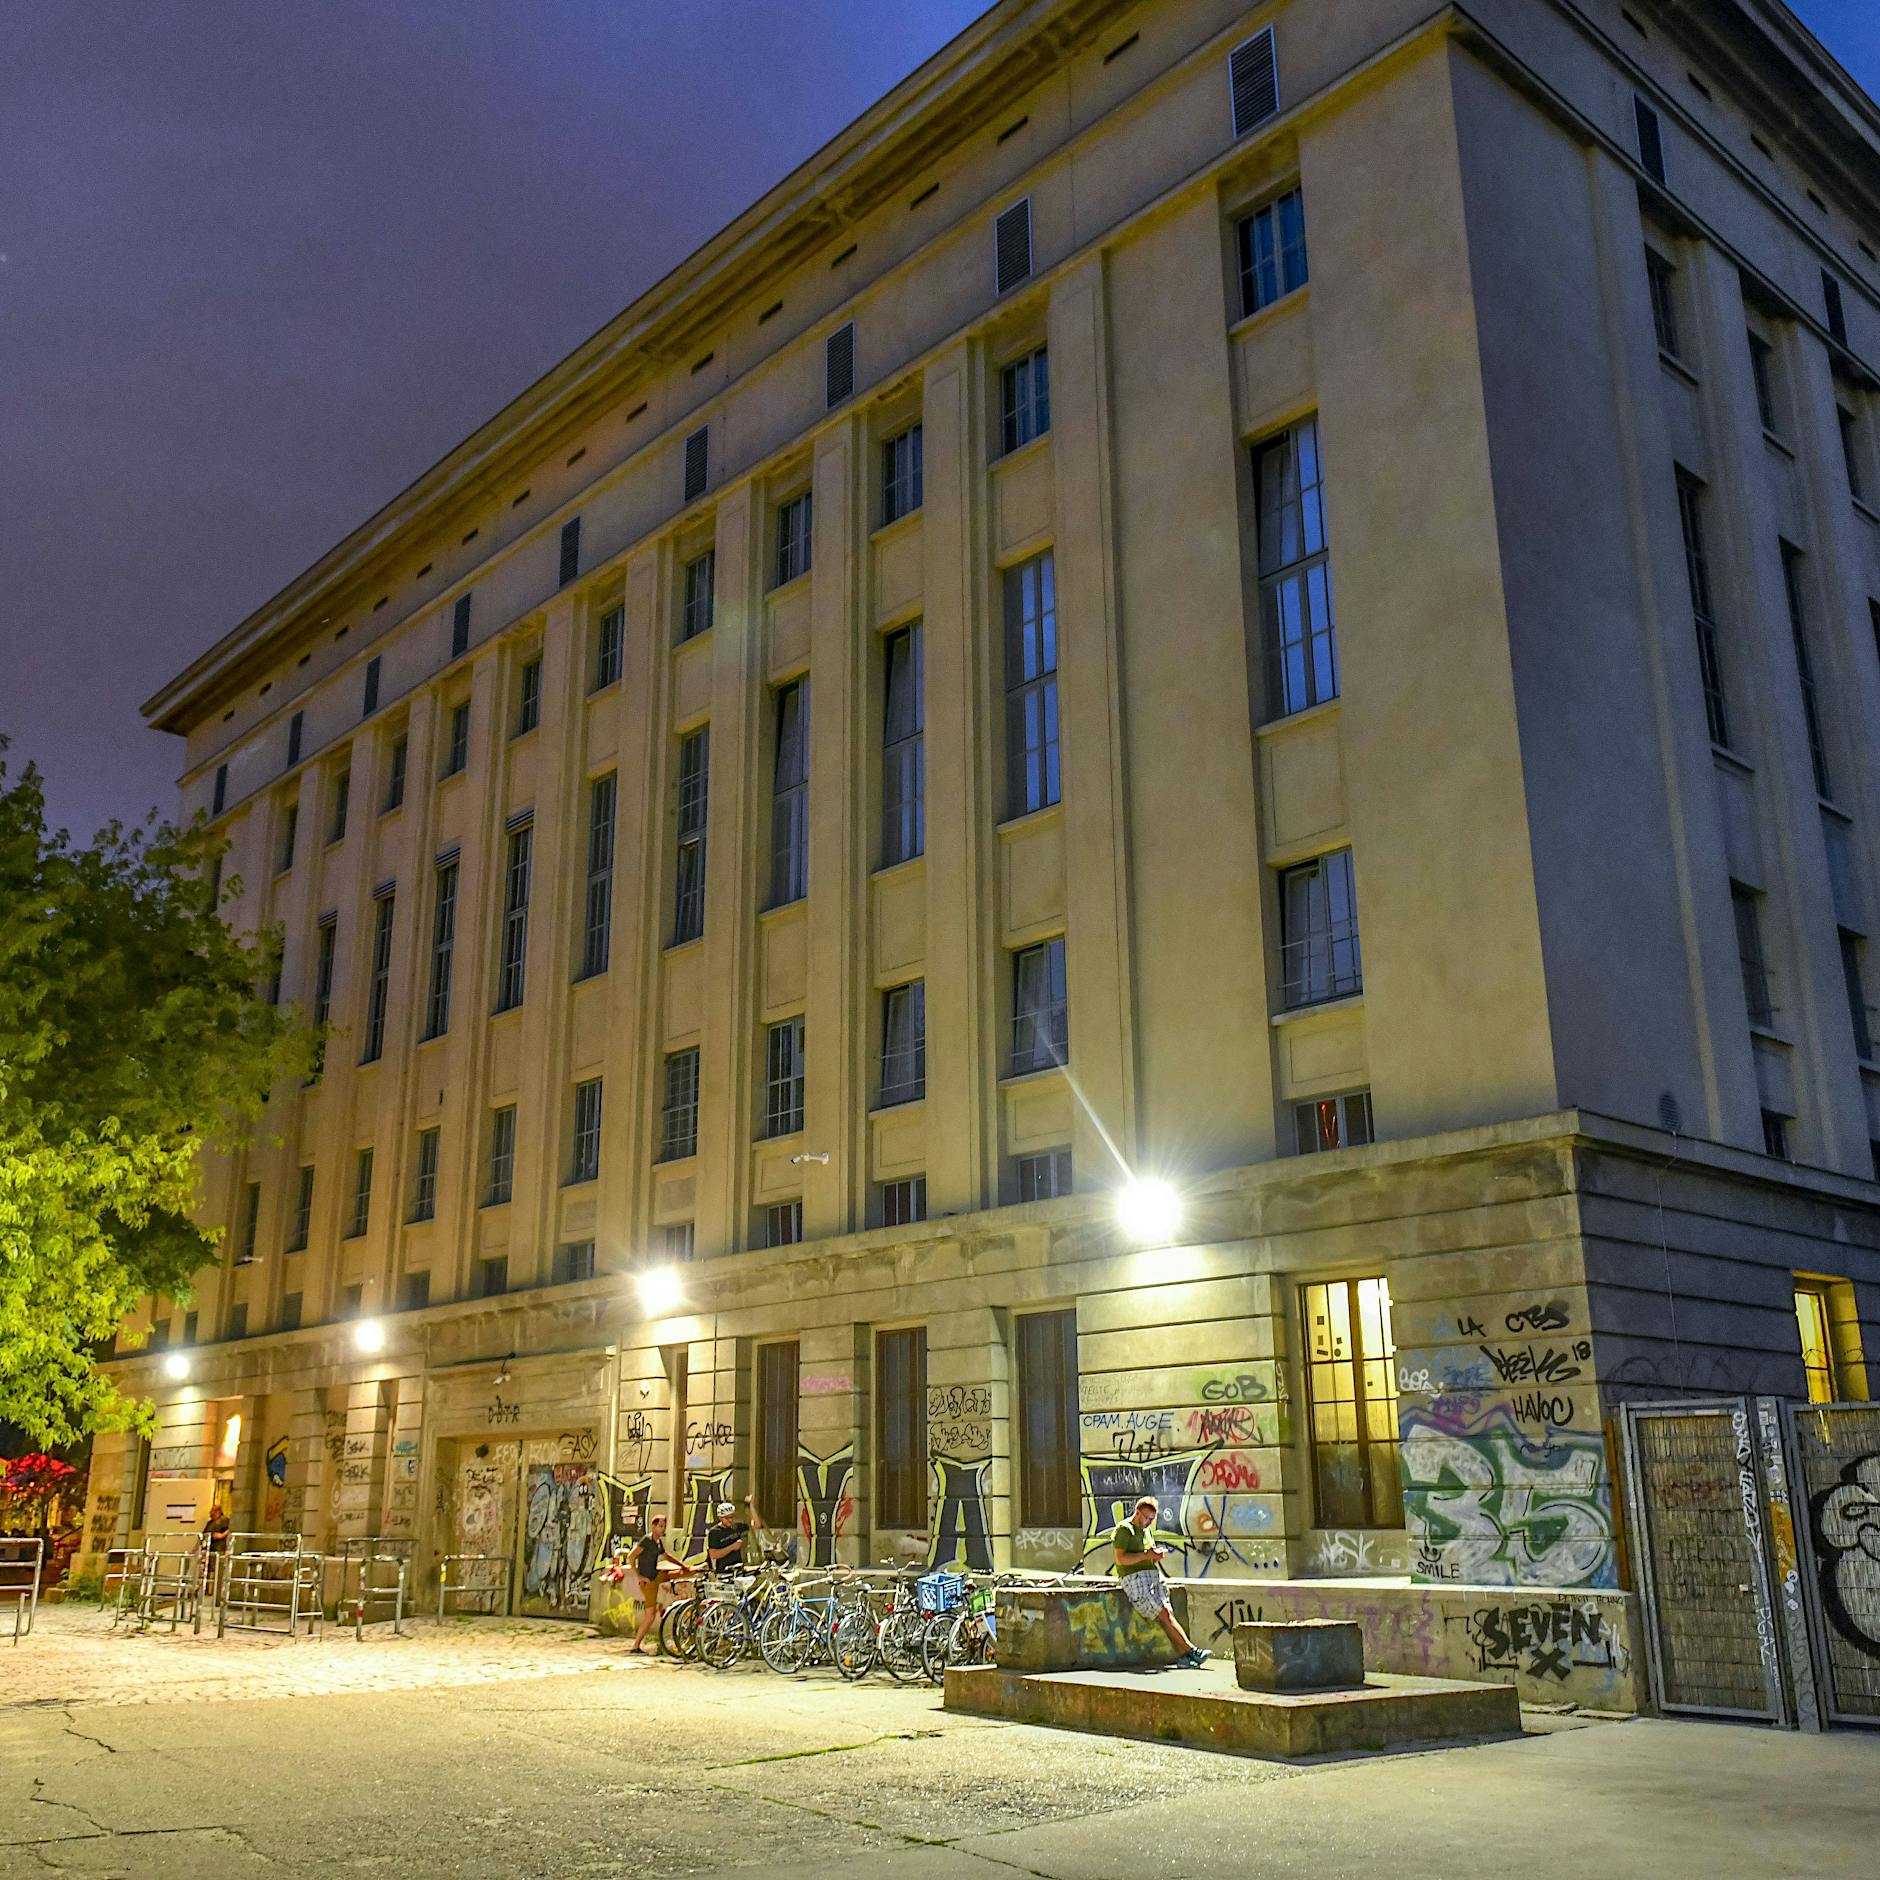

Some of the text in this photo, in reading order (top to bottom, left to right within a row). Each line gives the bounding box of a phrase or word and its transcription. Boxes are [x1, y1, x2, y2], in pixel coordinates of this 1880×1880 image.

[1512, 1390, 1574, 1426] HAVOC
[1415, 1561, 1461, 1579] SMILE
[1481, 1603, 1602, 1660] SEVEN
